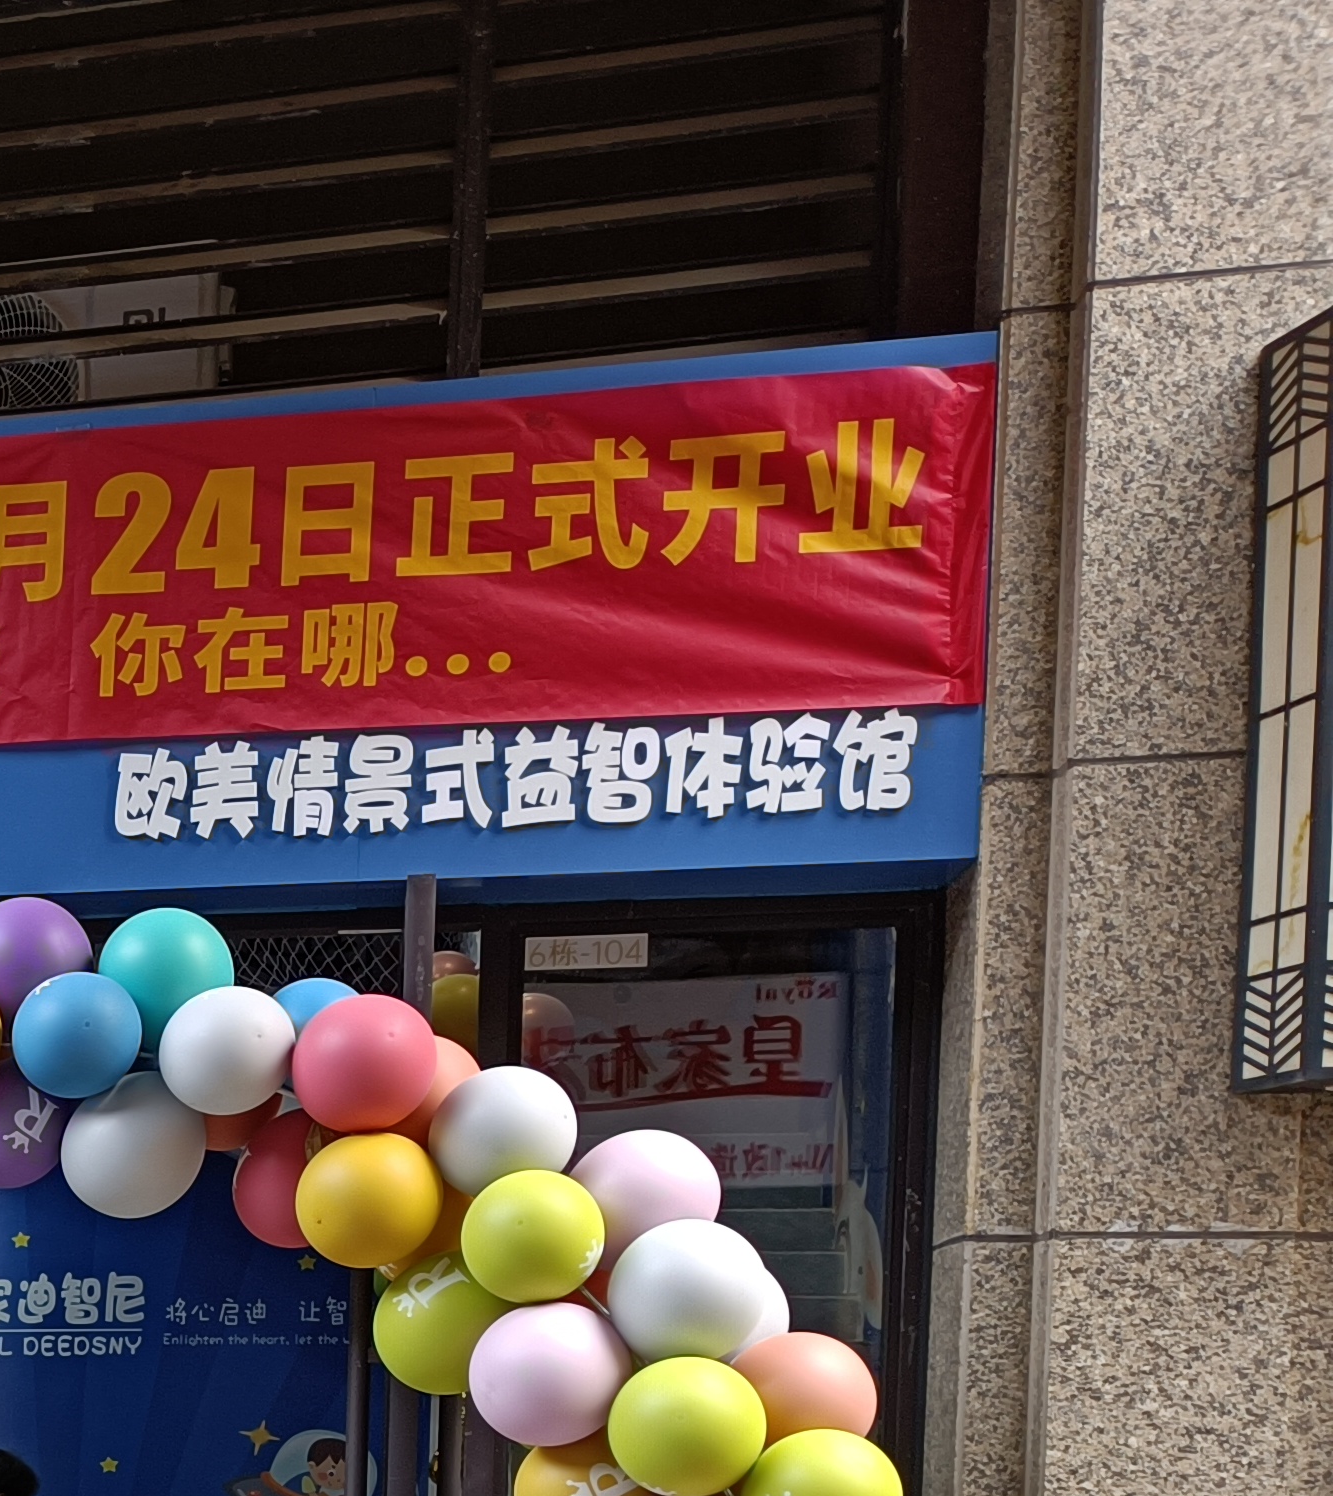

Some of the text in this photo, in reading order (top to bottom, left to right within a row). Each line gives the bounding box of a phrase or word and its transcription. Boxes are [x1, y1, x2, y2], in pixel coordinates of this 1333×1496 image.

[112, 708, 920, 843] 欧美情景式益智体验馆
[528, 936, 644, 969] 6栋-104
[165, 1297, 267, 1326] 将心启迪
[23, 1335, 143, 1357] DEEDSNY
[163, 1332, 224, 1347] Enlighten
[227, 1333, 249, 1346] the
[294, 1333, 313, 1346] let
[318, 1333, 339, 1346] the
